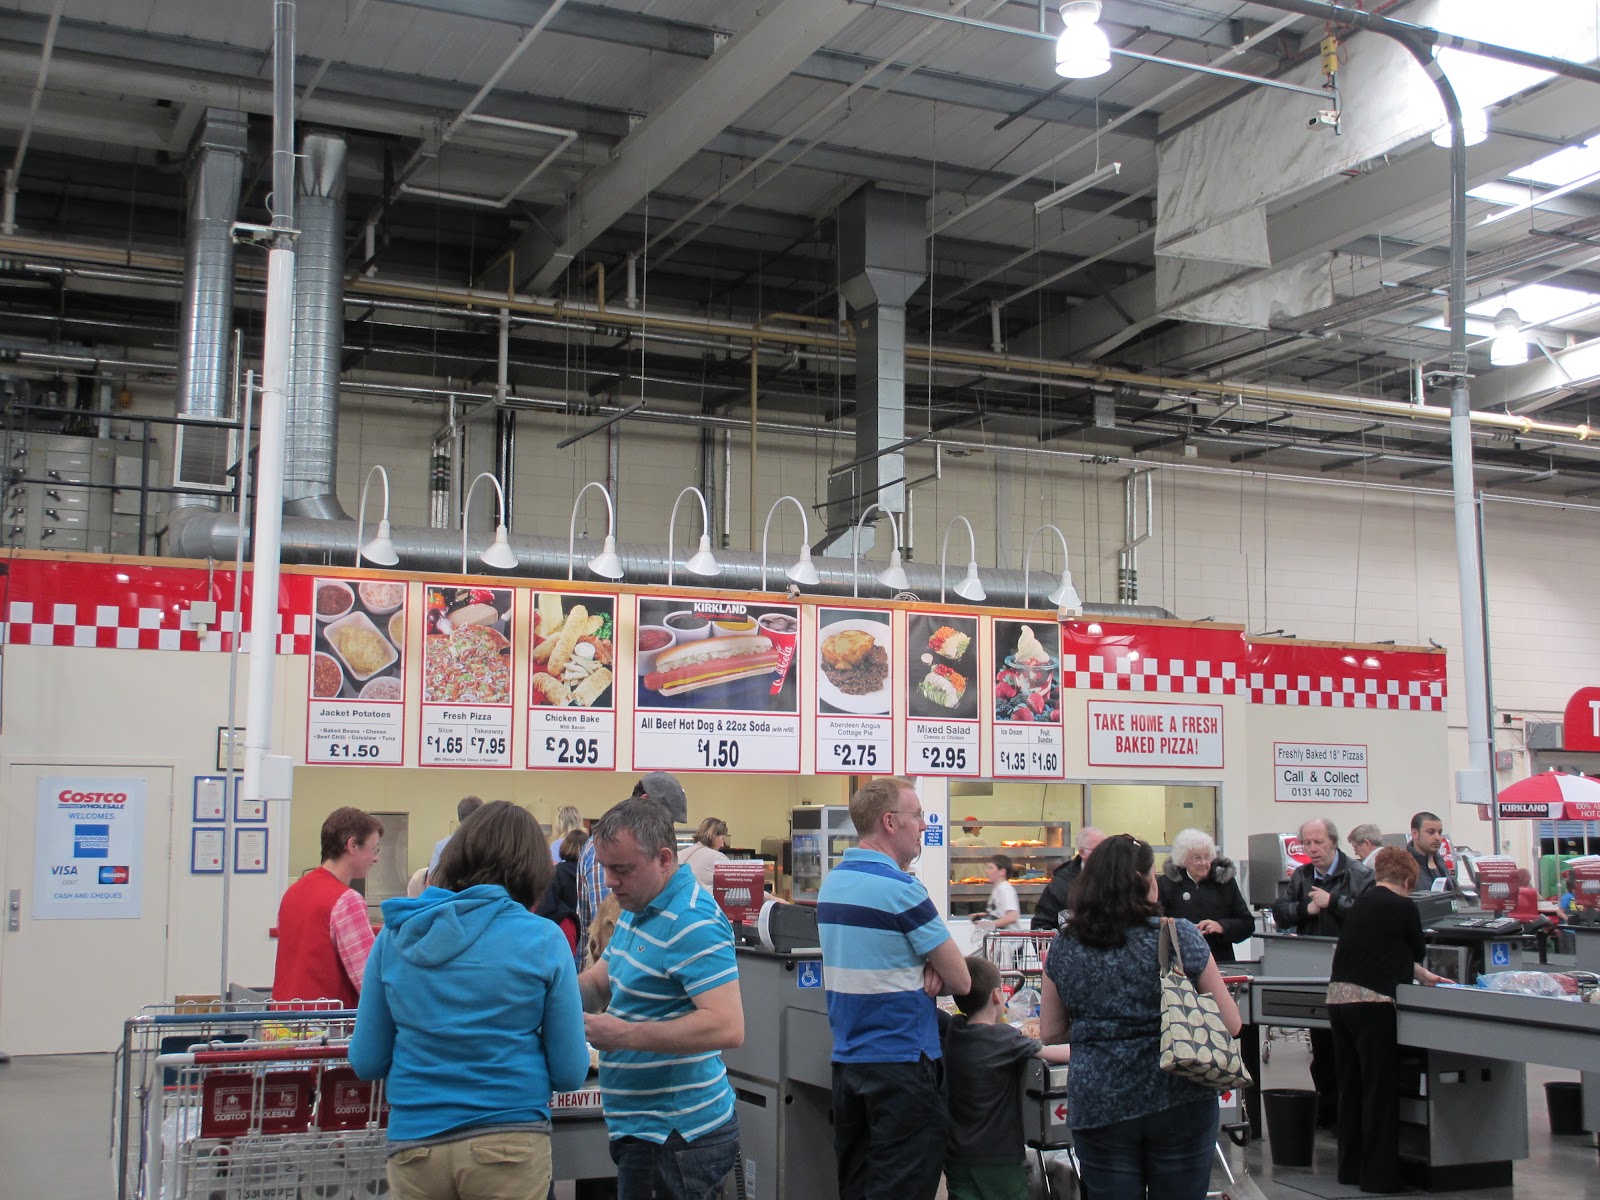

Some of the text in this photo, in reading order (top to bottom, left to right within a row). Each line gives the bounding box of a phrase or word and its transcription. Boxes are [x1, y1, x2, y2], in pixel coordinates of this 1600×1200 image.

[694, 602, 747, 614] KIRKLAND
[320, 709, 391, 718] Jacket Potatoes
[443, 712, 492, 720] Fresh Pizza
[545, 714, 600, 723] Chicken Bake
[641, 717, 653, 728] All
[656, 718, 676, 729] Beef
[679, 718, 695, 730] Hot
[697, 719, 714, 733] Dog
[717, 719, 723, 731] &
[726, 720, 747, 731] 22oz
[749, 720, 771, 732] Soda
[861, 722, 881, 730] Angus
[917, 724, 971, 735] Mixed Salad
[1094, 713, 1218, 734] TAKE HOME A FRESH
[838, 729, 862, 737] Cottage
[329, 743, 380, 758] £1.50
[427, 736, 463, 753] £1.65
[471, 737, 506, 754] £7.95
[546, 736, 599, 764] £2.95
[1116, 736, 1198, 754] BAKED PIZZA!
[697, 738, 739, 767] £1.50
[834, 744, 877, 766] £2.75
[922, 747, 966, 769] £2.95
[1278, 748, 1304, 761] Freshly
[1306, 749, 1327, 759] Baked
[1342, 750, 1364, 760] Pizzas
[1000, 751, 1025, 770] £1.35
[1032, 752, 1057, 771] £1.60
[1284, 770, 1359, 783] Call & Collect
[59, 790, 127, 803] COSTCO
[1291, 787, 1353, 797] 0131 440 7062
[1501, 804, 1548, 812] KIRKLAND
[51, 866, 78, 875] VISA
[558, 1093, 589, 1107] HEAVY
[335, 1106, 367, 1114] COSTCO
[214, 1113, 247, 1121] COSTCO
